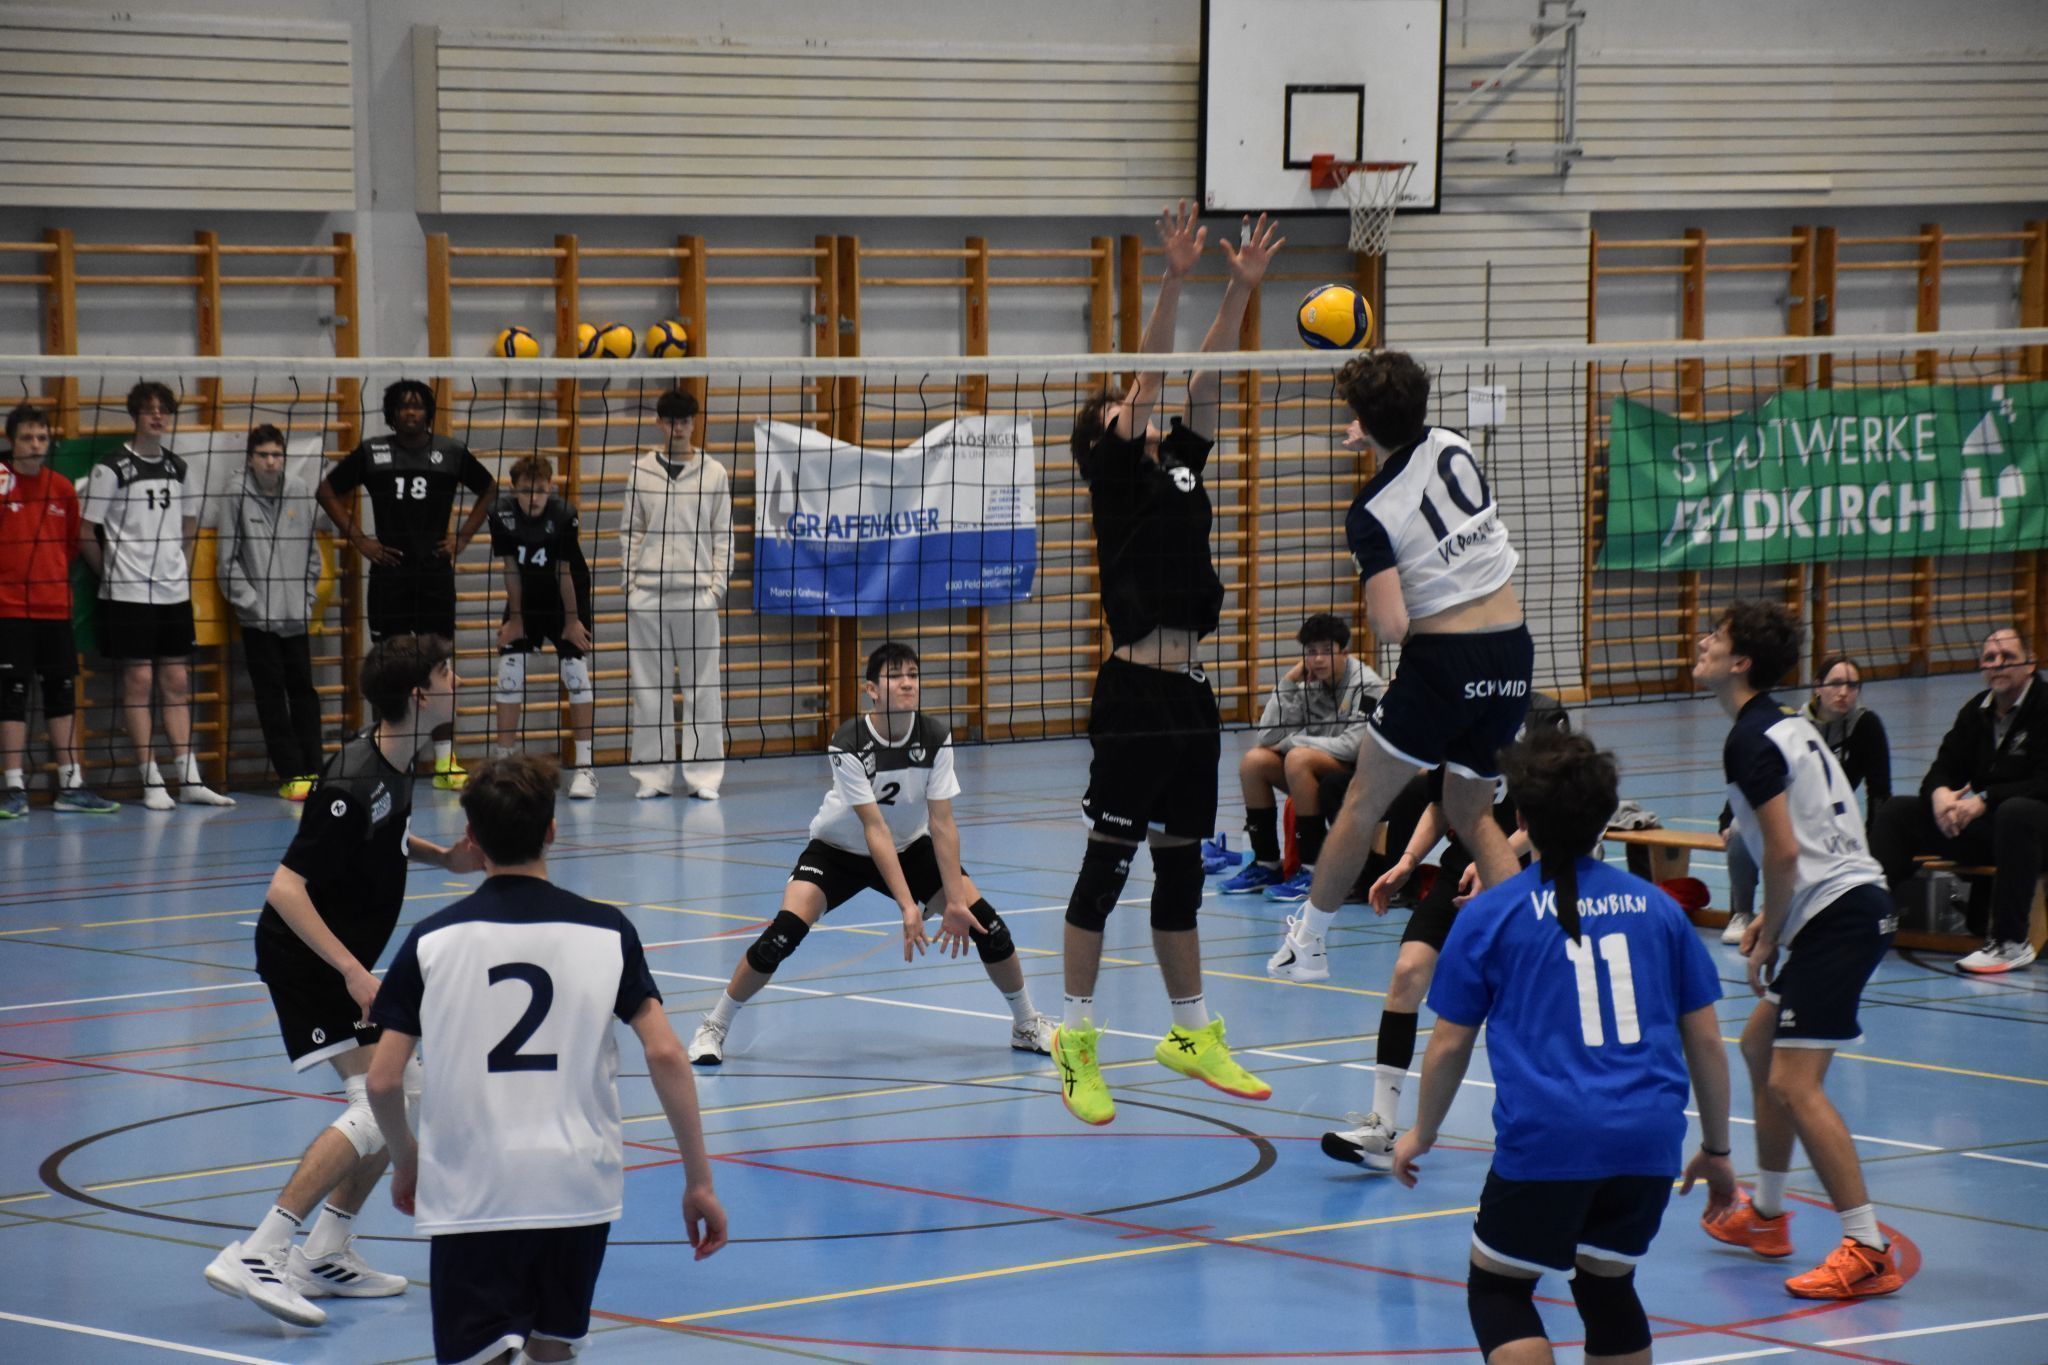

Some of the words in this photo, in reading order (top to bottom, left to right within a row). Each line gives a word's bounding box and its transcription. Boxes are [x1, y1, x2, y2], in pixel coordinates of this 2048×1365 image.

[146, 488, 171, 511] 13
[394, 476, 427, 499] 18
[1420, 445, 1491, 543] 10
[787, 507, 939, 540] GRAFENAUER
[517, 545, 548, 567] 14
[876, 782, 901, 806] 2
[1577, 894, 1647, 918] ORNBIRN
[1565, 933, 1641, 1047] 11
[487, 962, 558, 1073] 2
